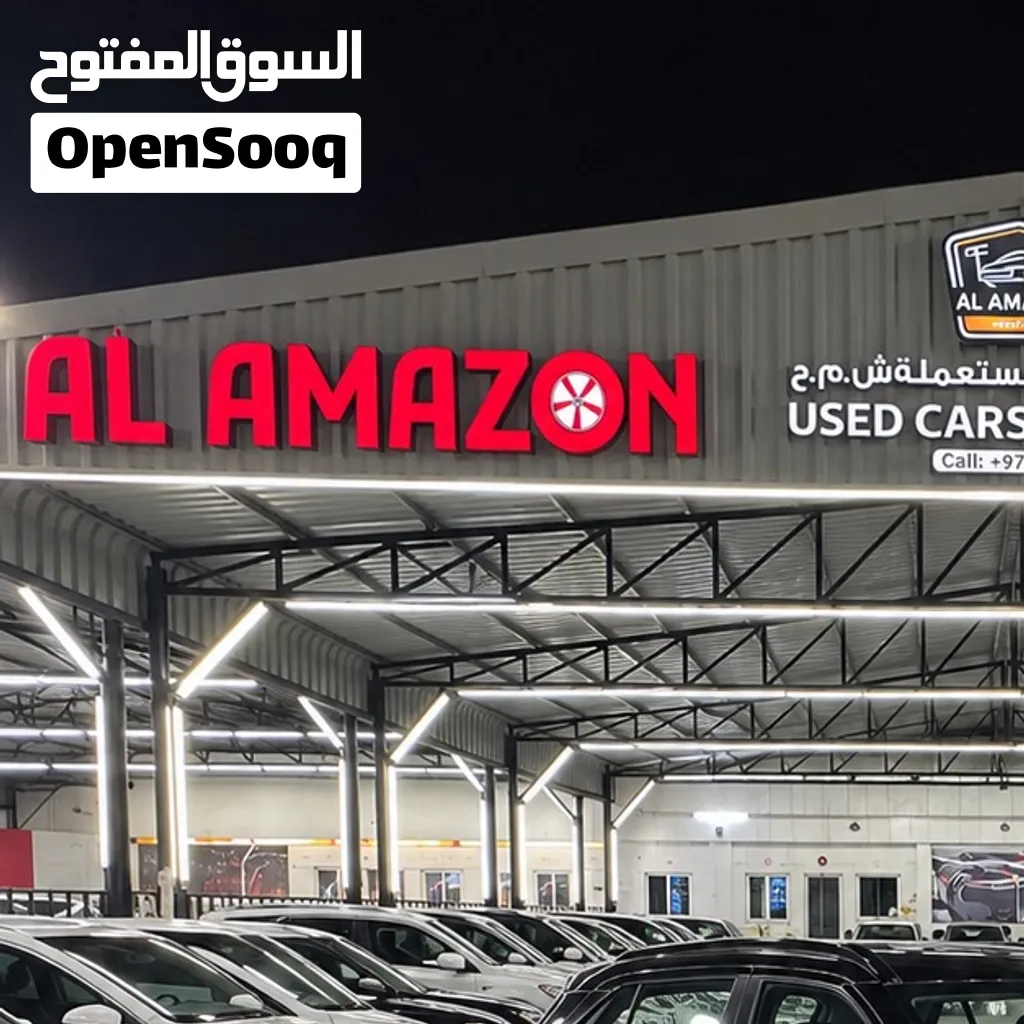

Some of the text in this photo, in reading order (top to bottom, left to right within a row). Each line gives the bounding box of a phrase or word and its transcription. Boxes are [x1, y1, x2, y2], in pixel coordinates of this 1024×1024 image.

[956, 292, 983, 311] AL
[23, 335, 698, 455] AL AMAZON
[788, 401, 903, 437] USED
[942, 453, 984, 470] Call:
